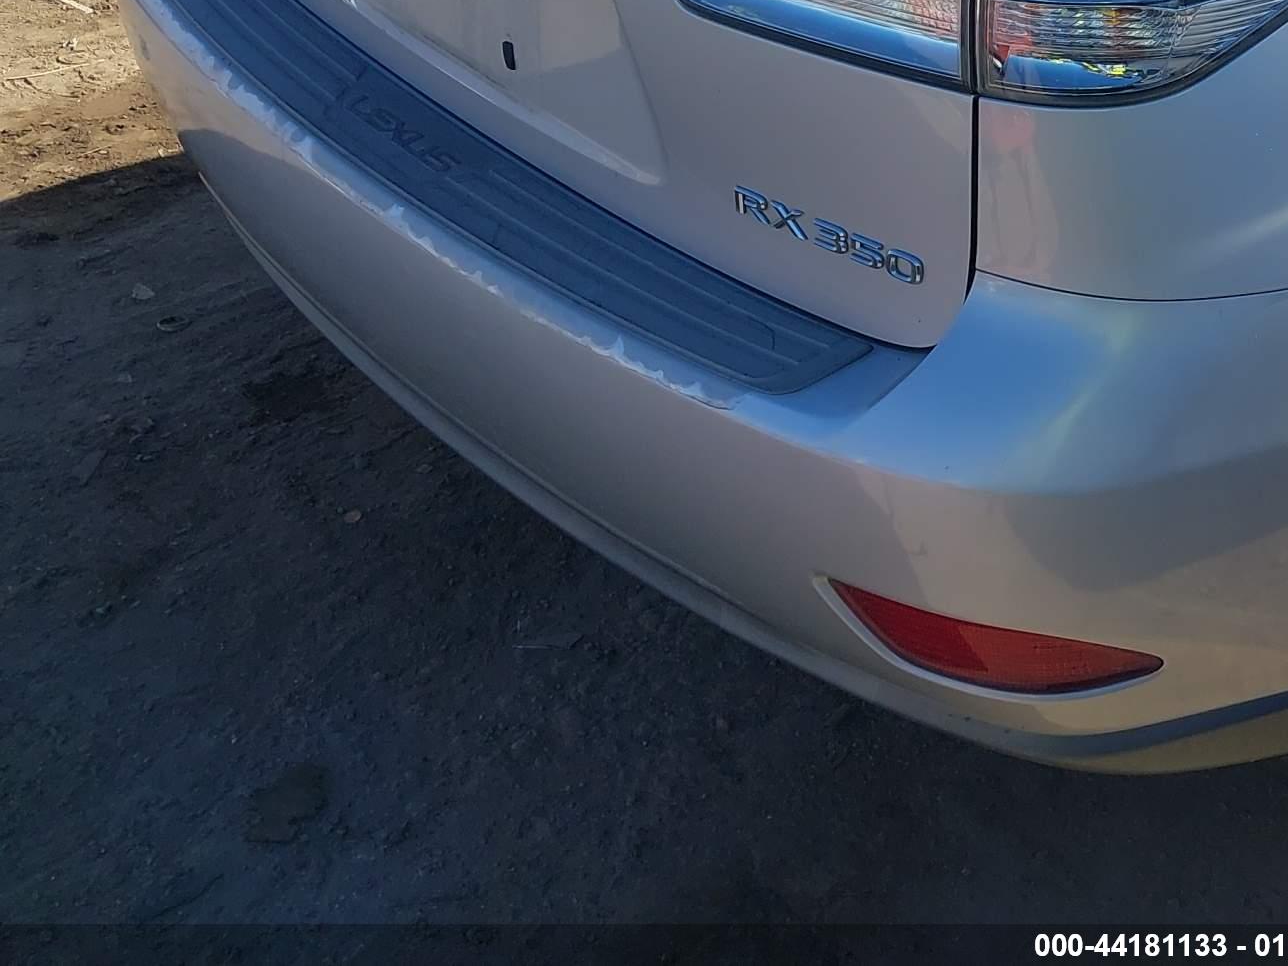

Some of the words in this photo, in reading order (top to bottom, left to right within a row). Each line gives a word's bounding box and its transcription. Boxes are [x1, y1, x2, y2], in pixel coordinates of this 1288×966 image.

[343, 94, 462, 173] LEXUS
[734, 185, 808, 241] RX
[811, 217, 925, 285] 350
